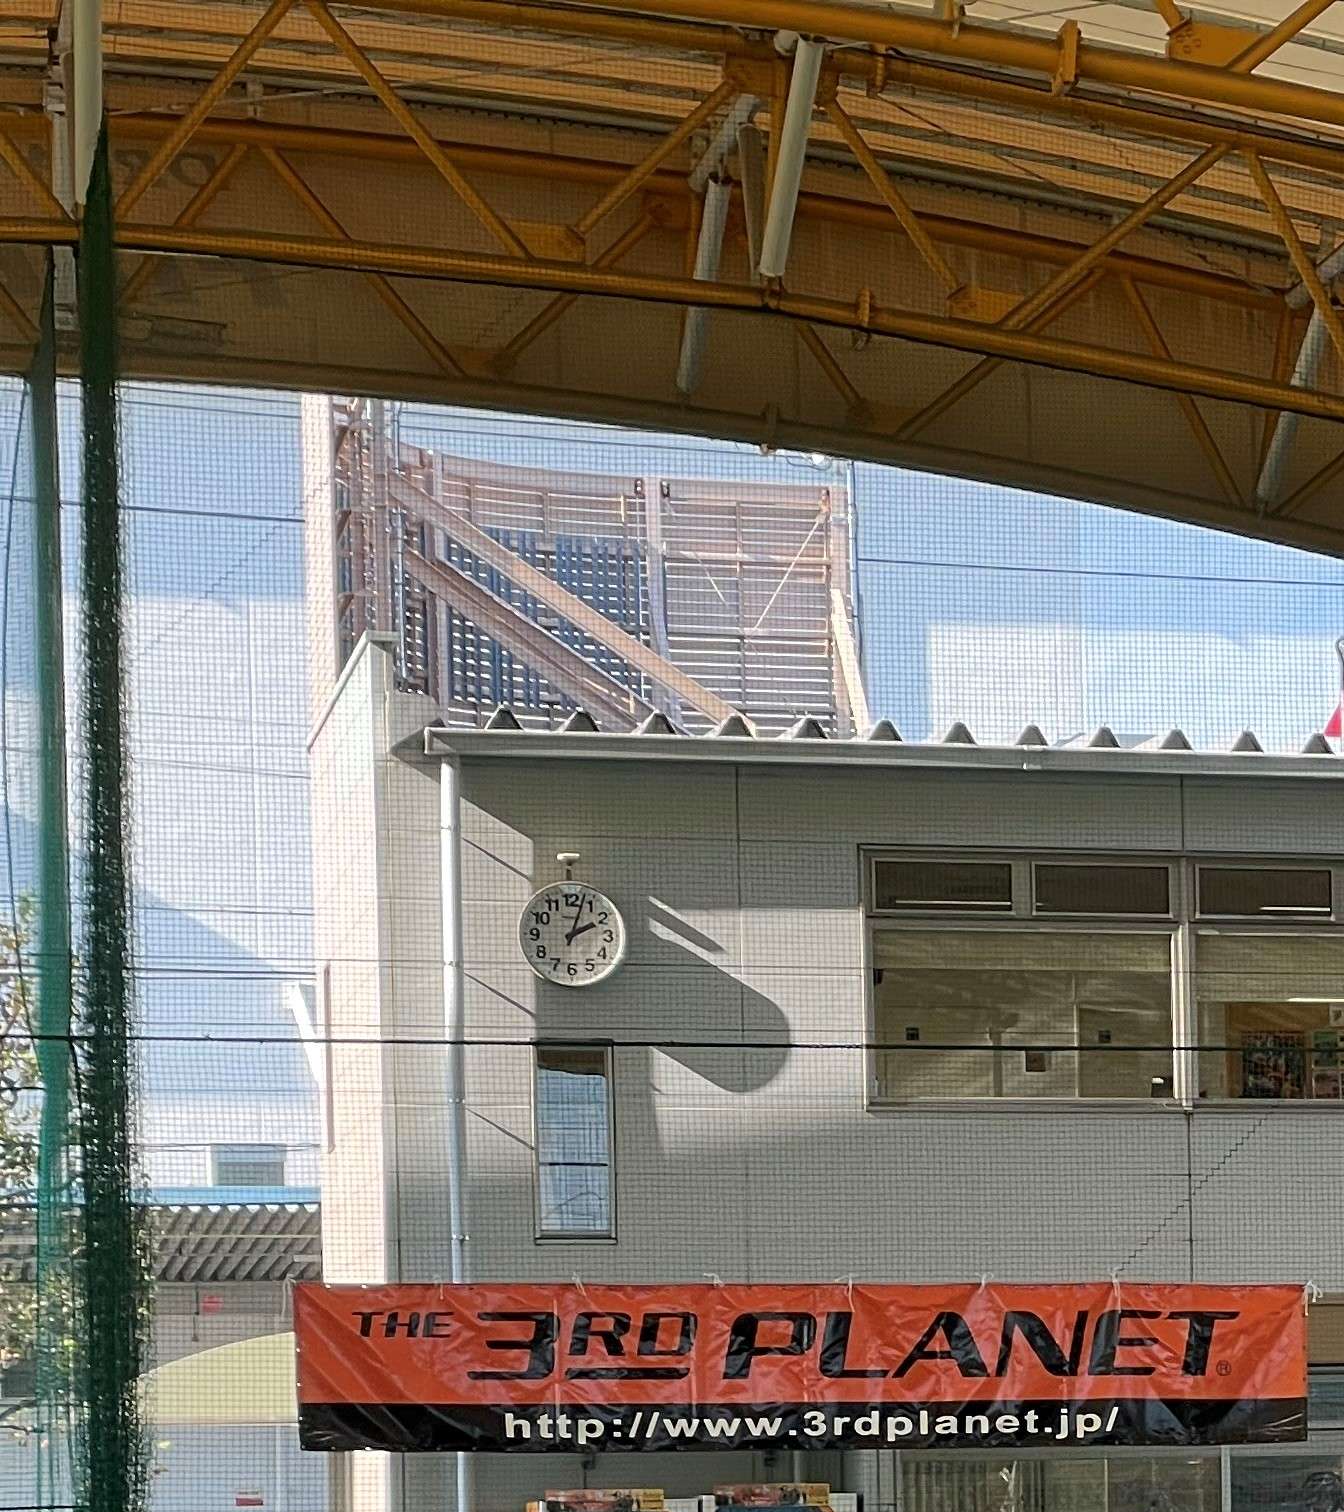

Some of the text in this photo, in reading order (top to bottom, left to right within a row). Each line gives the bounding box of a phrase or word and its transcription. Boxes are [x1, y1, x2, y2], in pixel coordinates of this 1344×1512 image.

[545, 898, 559, 911] 11
[563, 894, 581, 907] 12
[587, 900, 593, 912] 1
[532, 911, 550, 925] 10
[598, 912, 608, 924] 2
[529, 928, 540, 941] 9
[603, 930, 614, 943] 3
[536, 945, 546, 958] 8
[597, 947, 607, 959] 4
[550, 957, 560, 971] 7
[567, 963, 577, 976] 6
[585, 959, 595, 972] 5
[352, 1311, 1240, 1380] THE 3RD PLANET
[505, 1406, 1119, 1445] http://www.3rdplanet.jp/
